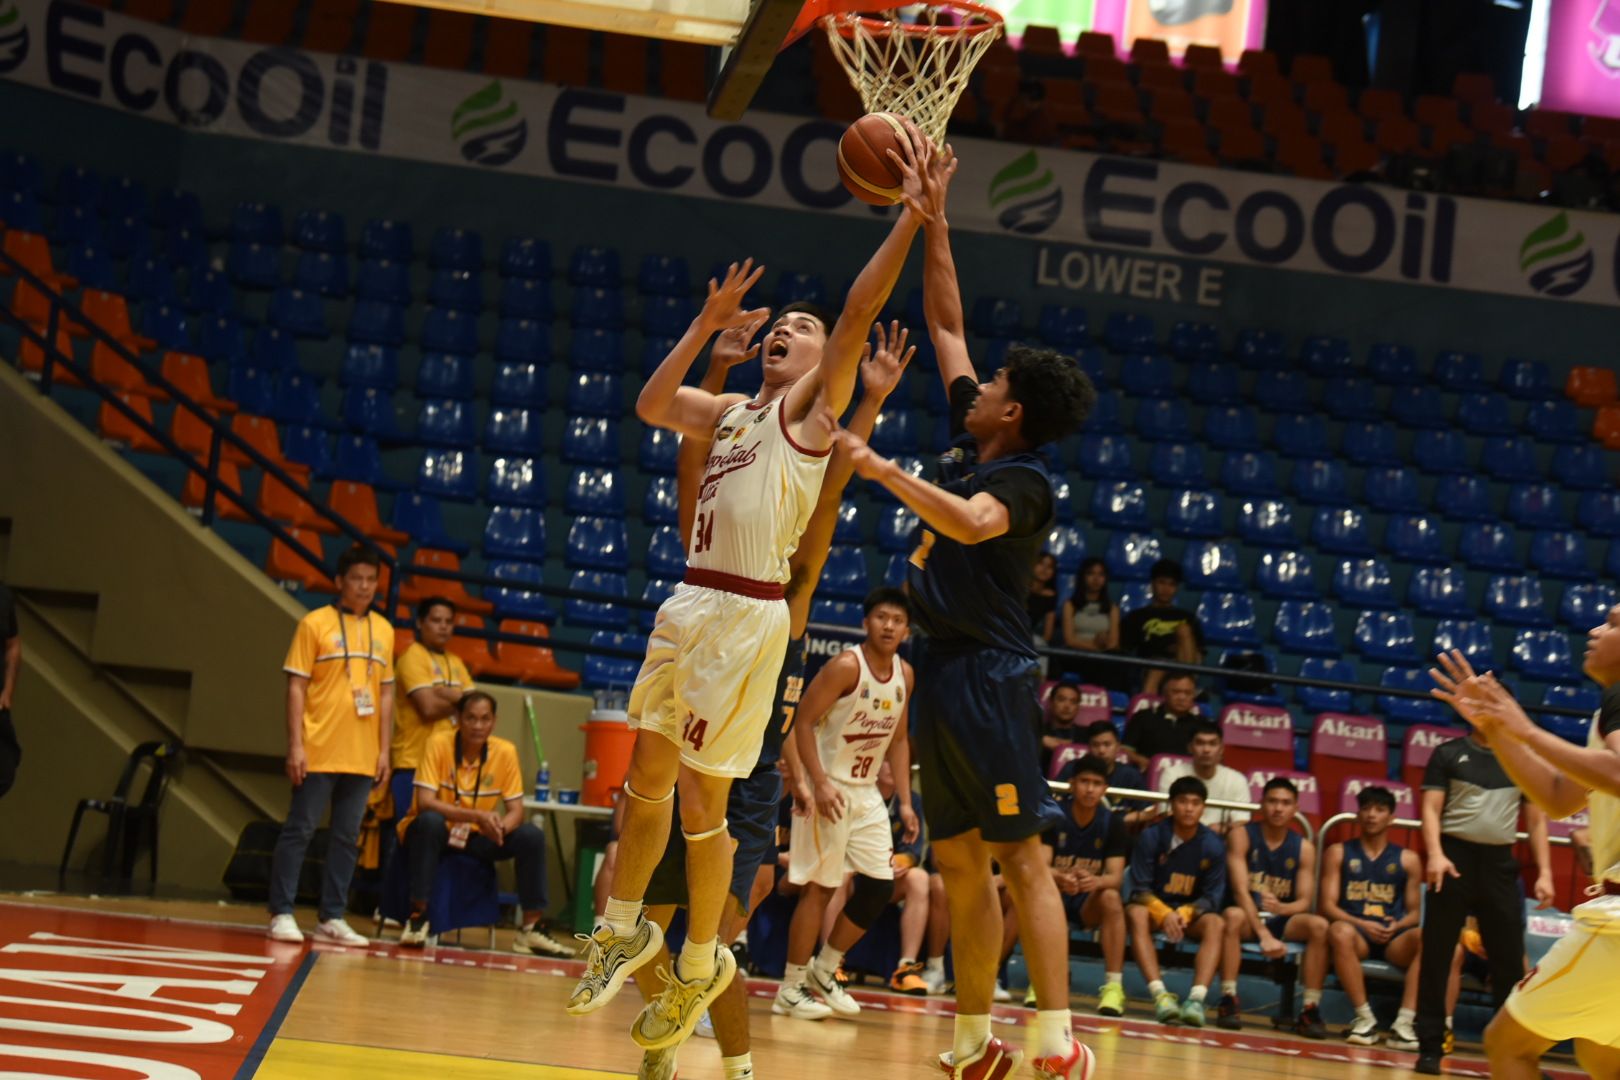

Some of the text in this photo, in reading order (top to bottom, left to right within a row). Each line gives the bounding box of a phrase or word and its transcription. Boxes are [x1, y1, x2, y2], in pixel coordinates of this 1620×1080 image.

[46, 0, 389, 150] EcoOil
[547, 91, 890, 215] EcoO
[1083, 157, 1457, 284] EcoOil
[1036, 247, 1225, 307] LOWER E
[694, 509, 714, 553] 34
[1224, 708, 1292, 730] Akari
[1318, 717, 1386, 741] Akari
[851, 755, 874, 779] 28
[993, 782, 1021, 817] 2
